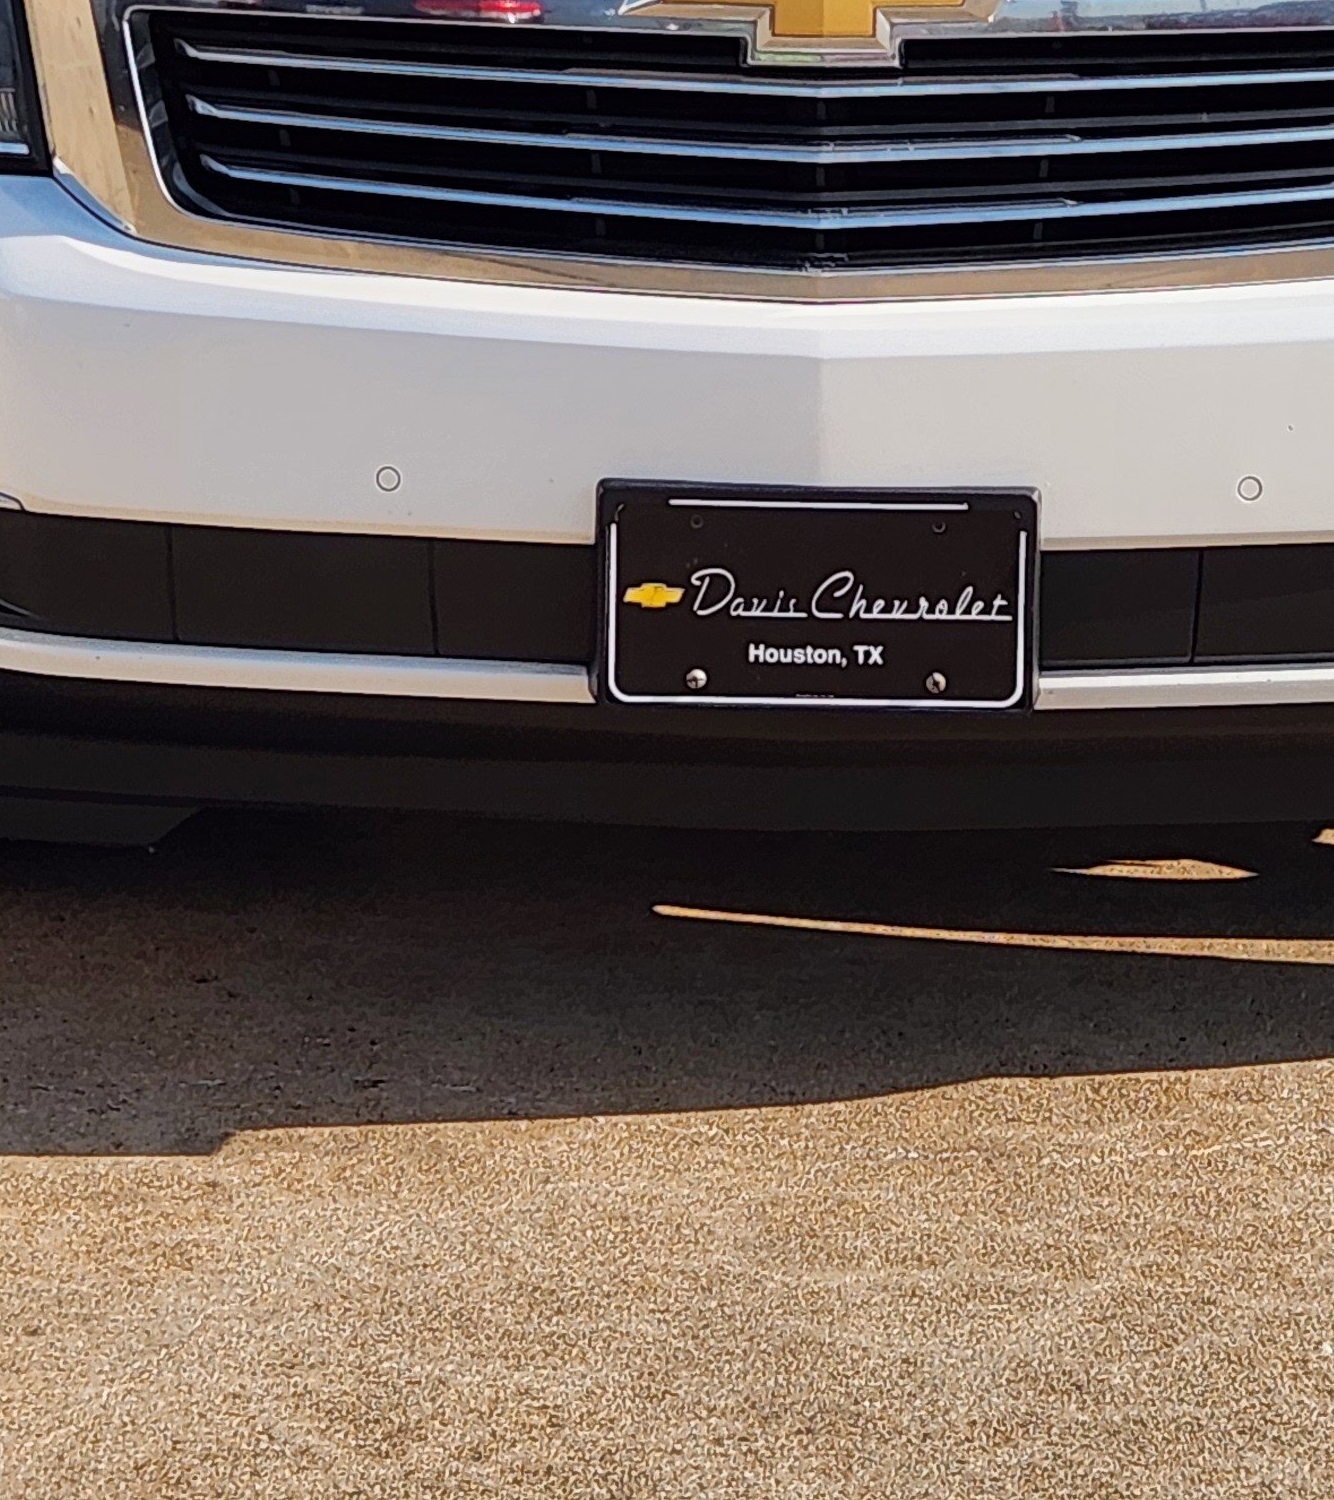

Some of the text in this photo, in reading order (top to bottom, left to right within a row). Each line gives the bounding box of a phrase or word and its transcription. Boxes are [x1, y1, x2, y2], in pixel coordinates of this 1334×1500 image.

[690, 567, 1013, 621] Davis Chevrolet
[748, 643, 884, 668] Houston, TX
